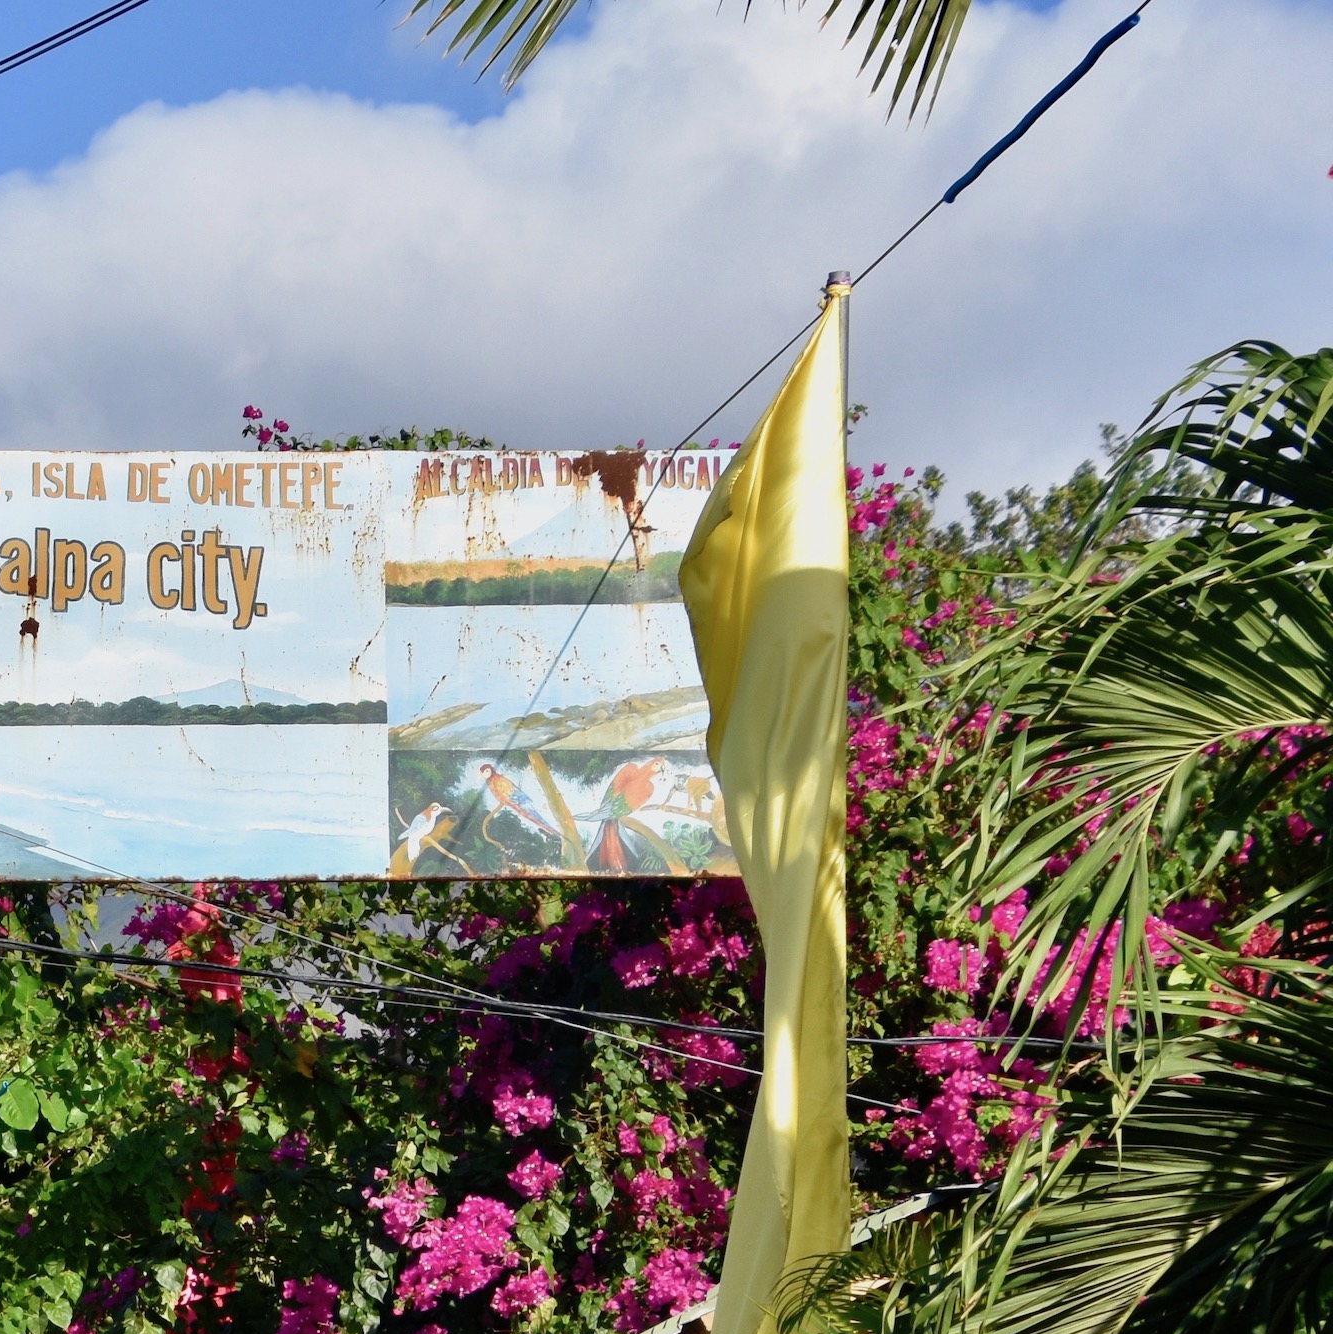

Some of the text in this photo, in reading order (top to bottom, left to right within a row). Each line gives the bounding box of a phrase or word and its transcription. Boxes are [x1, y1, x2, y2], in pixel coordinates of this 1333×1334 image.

[32, 461, 108, 501] ISLA
[127, 459, 176, 505] DE
[416, 457, 545, 499] ALCALDIA
[146, 528, 269, 631] city.
